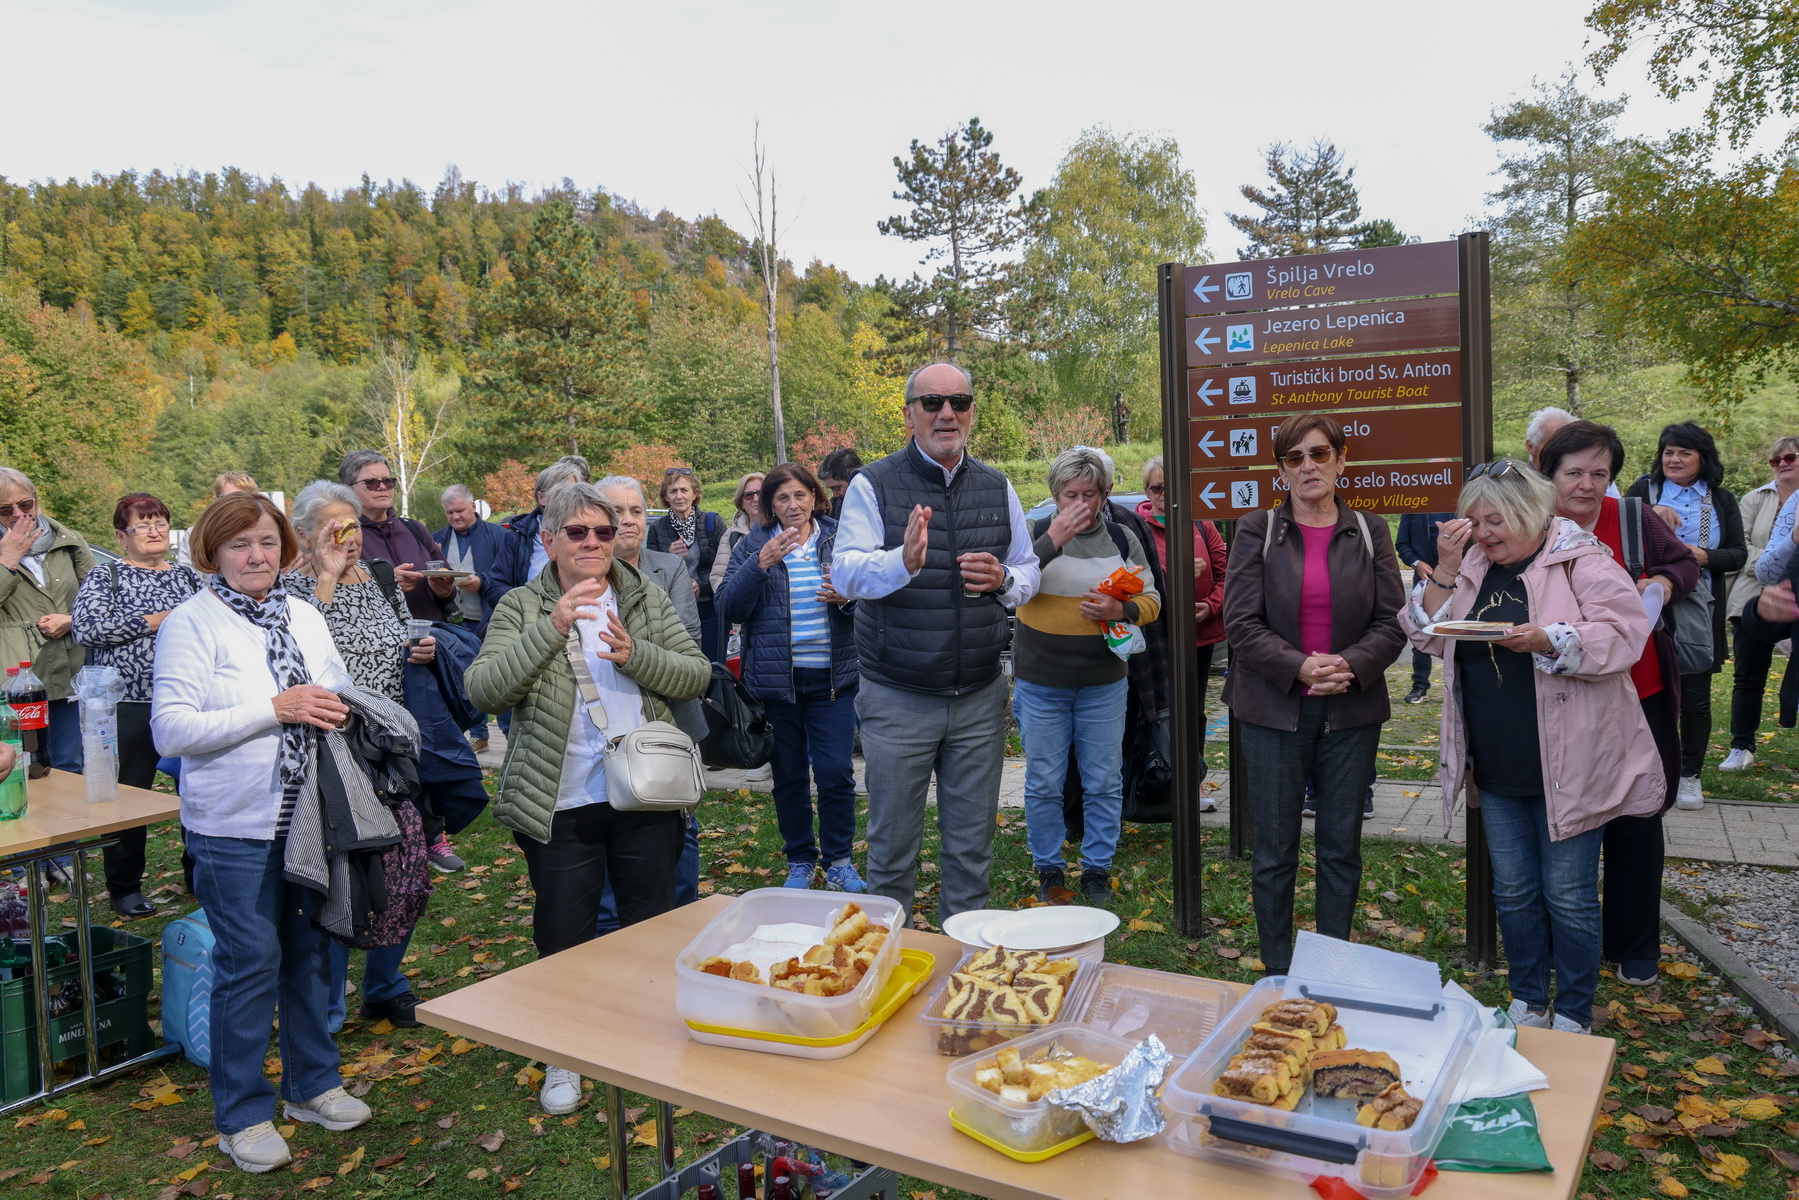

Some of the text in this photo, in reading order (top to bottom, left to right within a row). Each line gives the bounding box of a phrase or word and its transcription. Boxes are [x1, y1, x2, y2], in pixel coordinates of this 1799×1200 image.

[1266, 259, 1375, 287] Špilja Vrelo
[1267, 284, 1336, 300] Vrelo Cave
[1262, 309, 1405, 334] Jezero Lepenica
[1263, 336, 1354, 355] Lepenica Lake
[1270, 362, 1452, 386] Turistički brod Sv. Anton
[1270, 384, 1430, 405] St Anthony Tourist Boat
[1353, 472, 1386, 488] selo
[1390, 468, 1453, 487] Roswell
[1383, 493, 1429, 509] Village
[58, 1019, 112, 1044] MINENA
